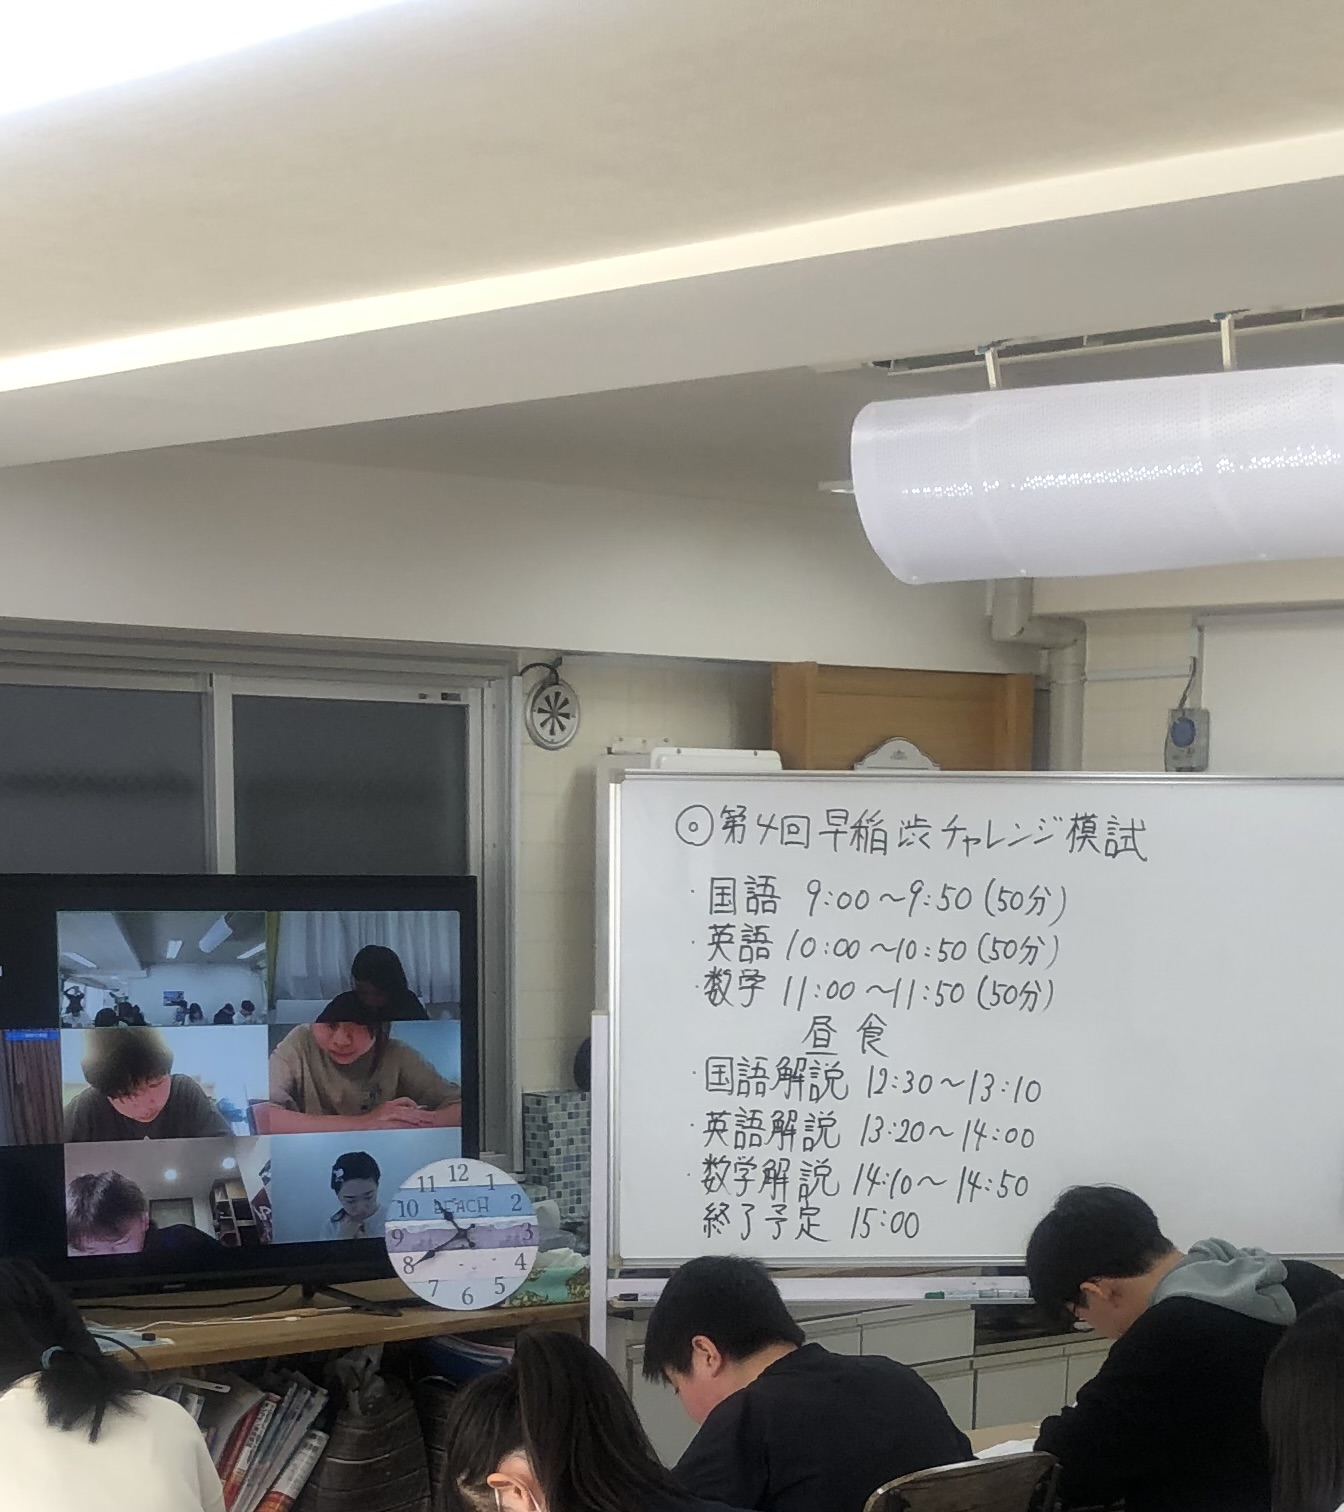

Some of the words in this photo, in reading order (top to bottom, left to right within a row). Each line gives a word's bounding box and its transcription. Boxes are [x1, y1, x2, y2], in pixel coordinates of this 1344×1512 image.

[710, 875, 781, 916] 国語
[985, 878, 1066, 927] (50分)
[707, 923, 773, 963] 英語
[978, 932, 1058, 970] (50分)
[704, 966, 766, 1008] 数学
[978, 975, 1053, 1012] (50分)
[802, 1013, 889, 1057] 昼食
[706, 1056, 848, 1103] 国語解説
[703, 1106, 840, 1152] 英語解説
[448, 1163, 469, 1182] 12
[701, 1153, 839, 1202] 数学解説
[417, 1175, 437, 1193] 11
[486, 1174, 496, 1191] 1
[396, 1199, 419, 1218] 10
[434, 1196, 489, 1215] BEACH
[510, 1194, 522, 1212] 2
[703, 1200, 831, 1242] 終了予定
[850, 1207, 919, 1239] 15:00
[391, 1229, 404, 1247] 9
[522, 1222, 534, 1241] 3
[403, 1256, 415, 1275] 8
[514, 1252, 527, 1271] 4
[428, 1279, 439, 1297] 7
[494, 1276, 505, 1295] 5
[461, 1287, 474, 1305] 6
